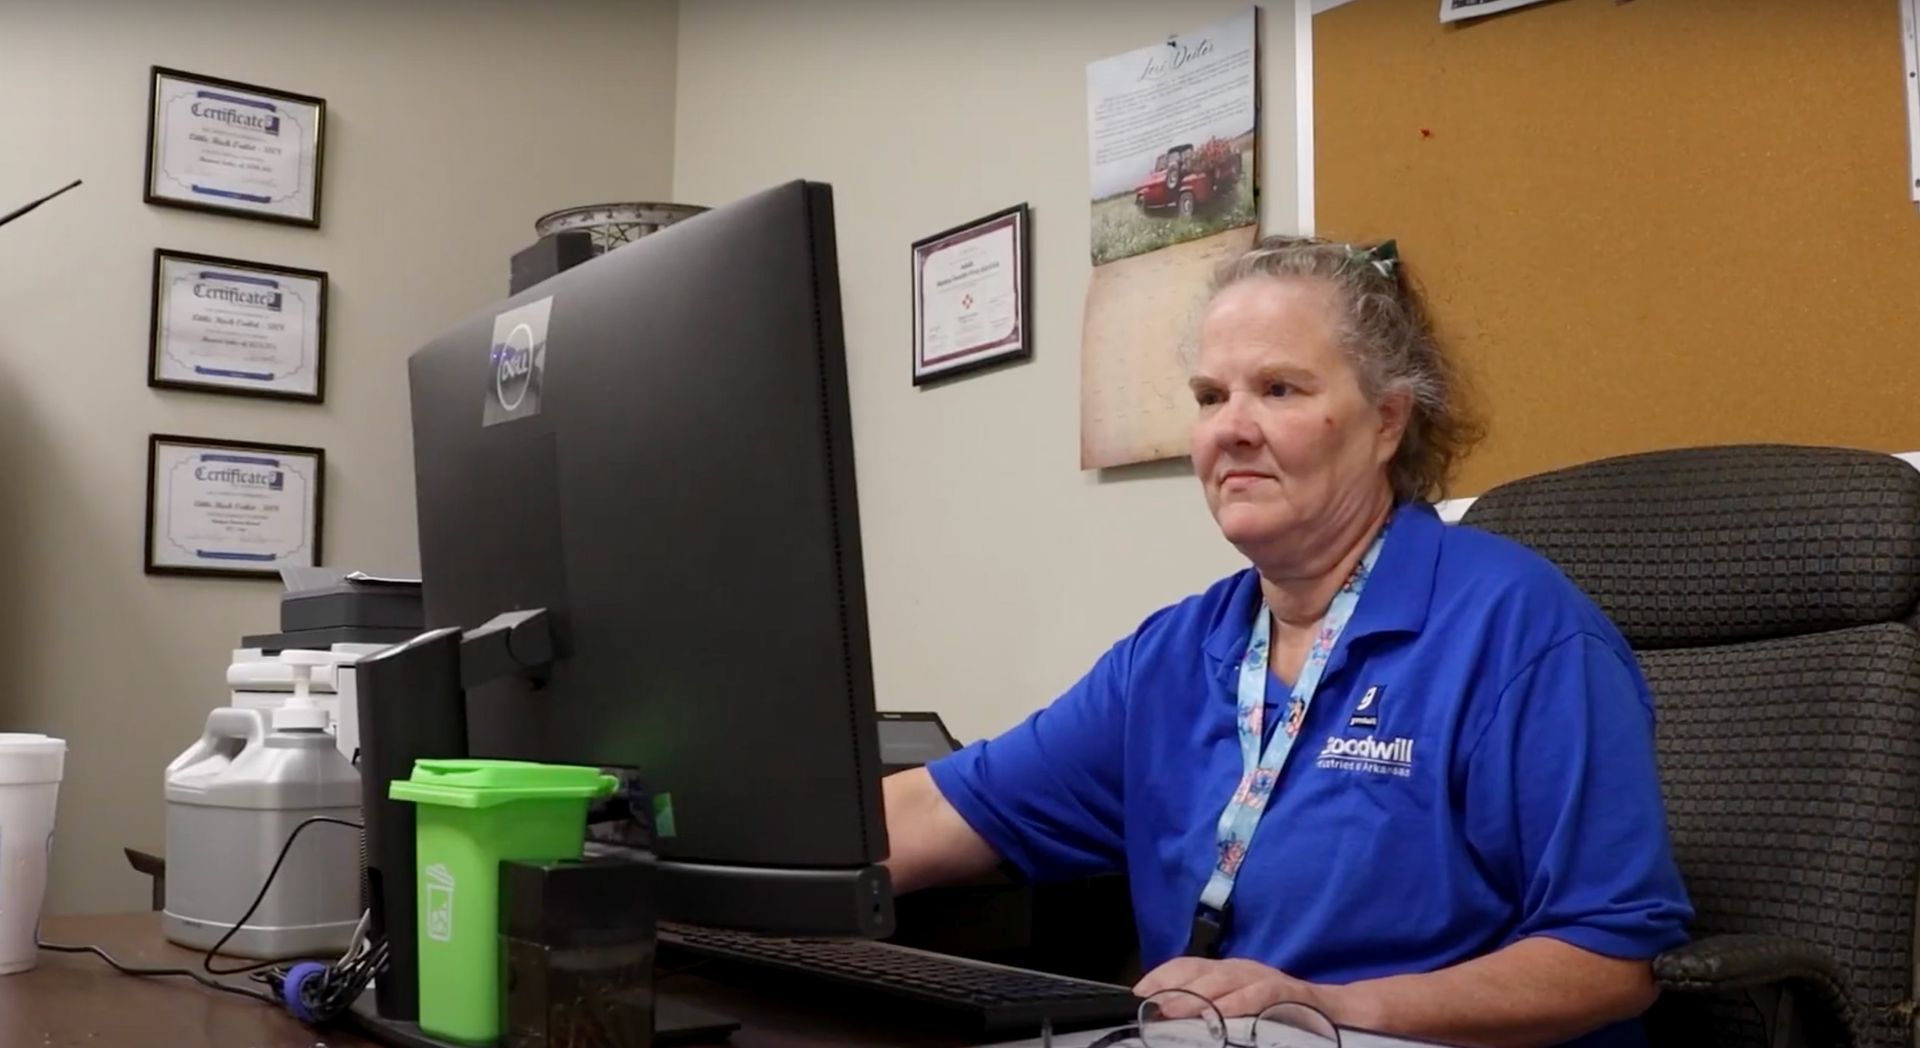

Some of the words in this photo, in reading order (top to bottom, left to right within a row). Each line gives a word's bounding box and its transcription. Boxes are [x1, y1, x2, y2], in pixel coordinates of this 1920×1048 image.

[191, 102, 264, 128] Certificate
[193, 283, 267, 305] Certificate
[502, 351, 529, 381] DELL
[194, 466, 268, 486] Certificate
